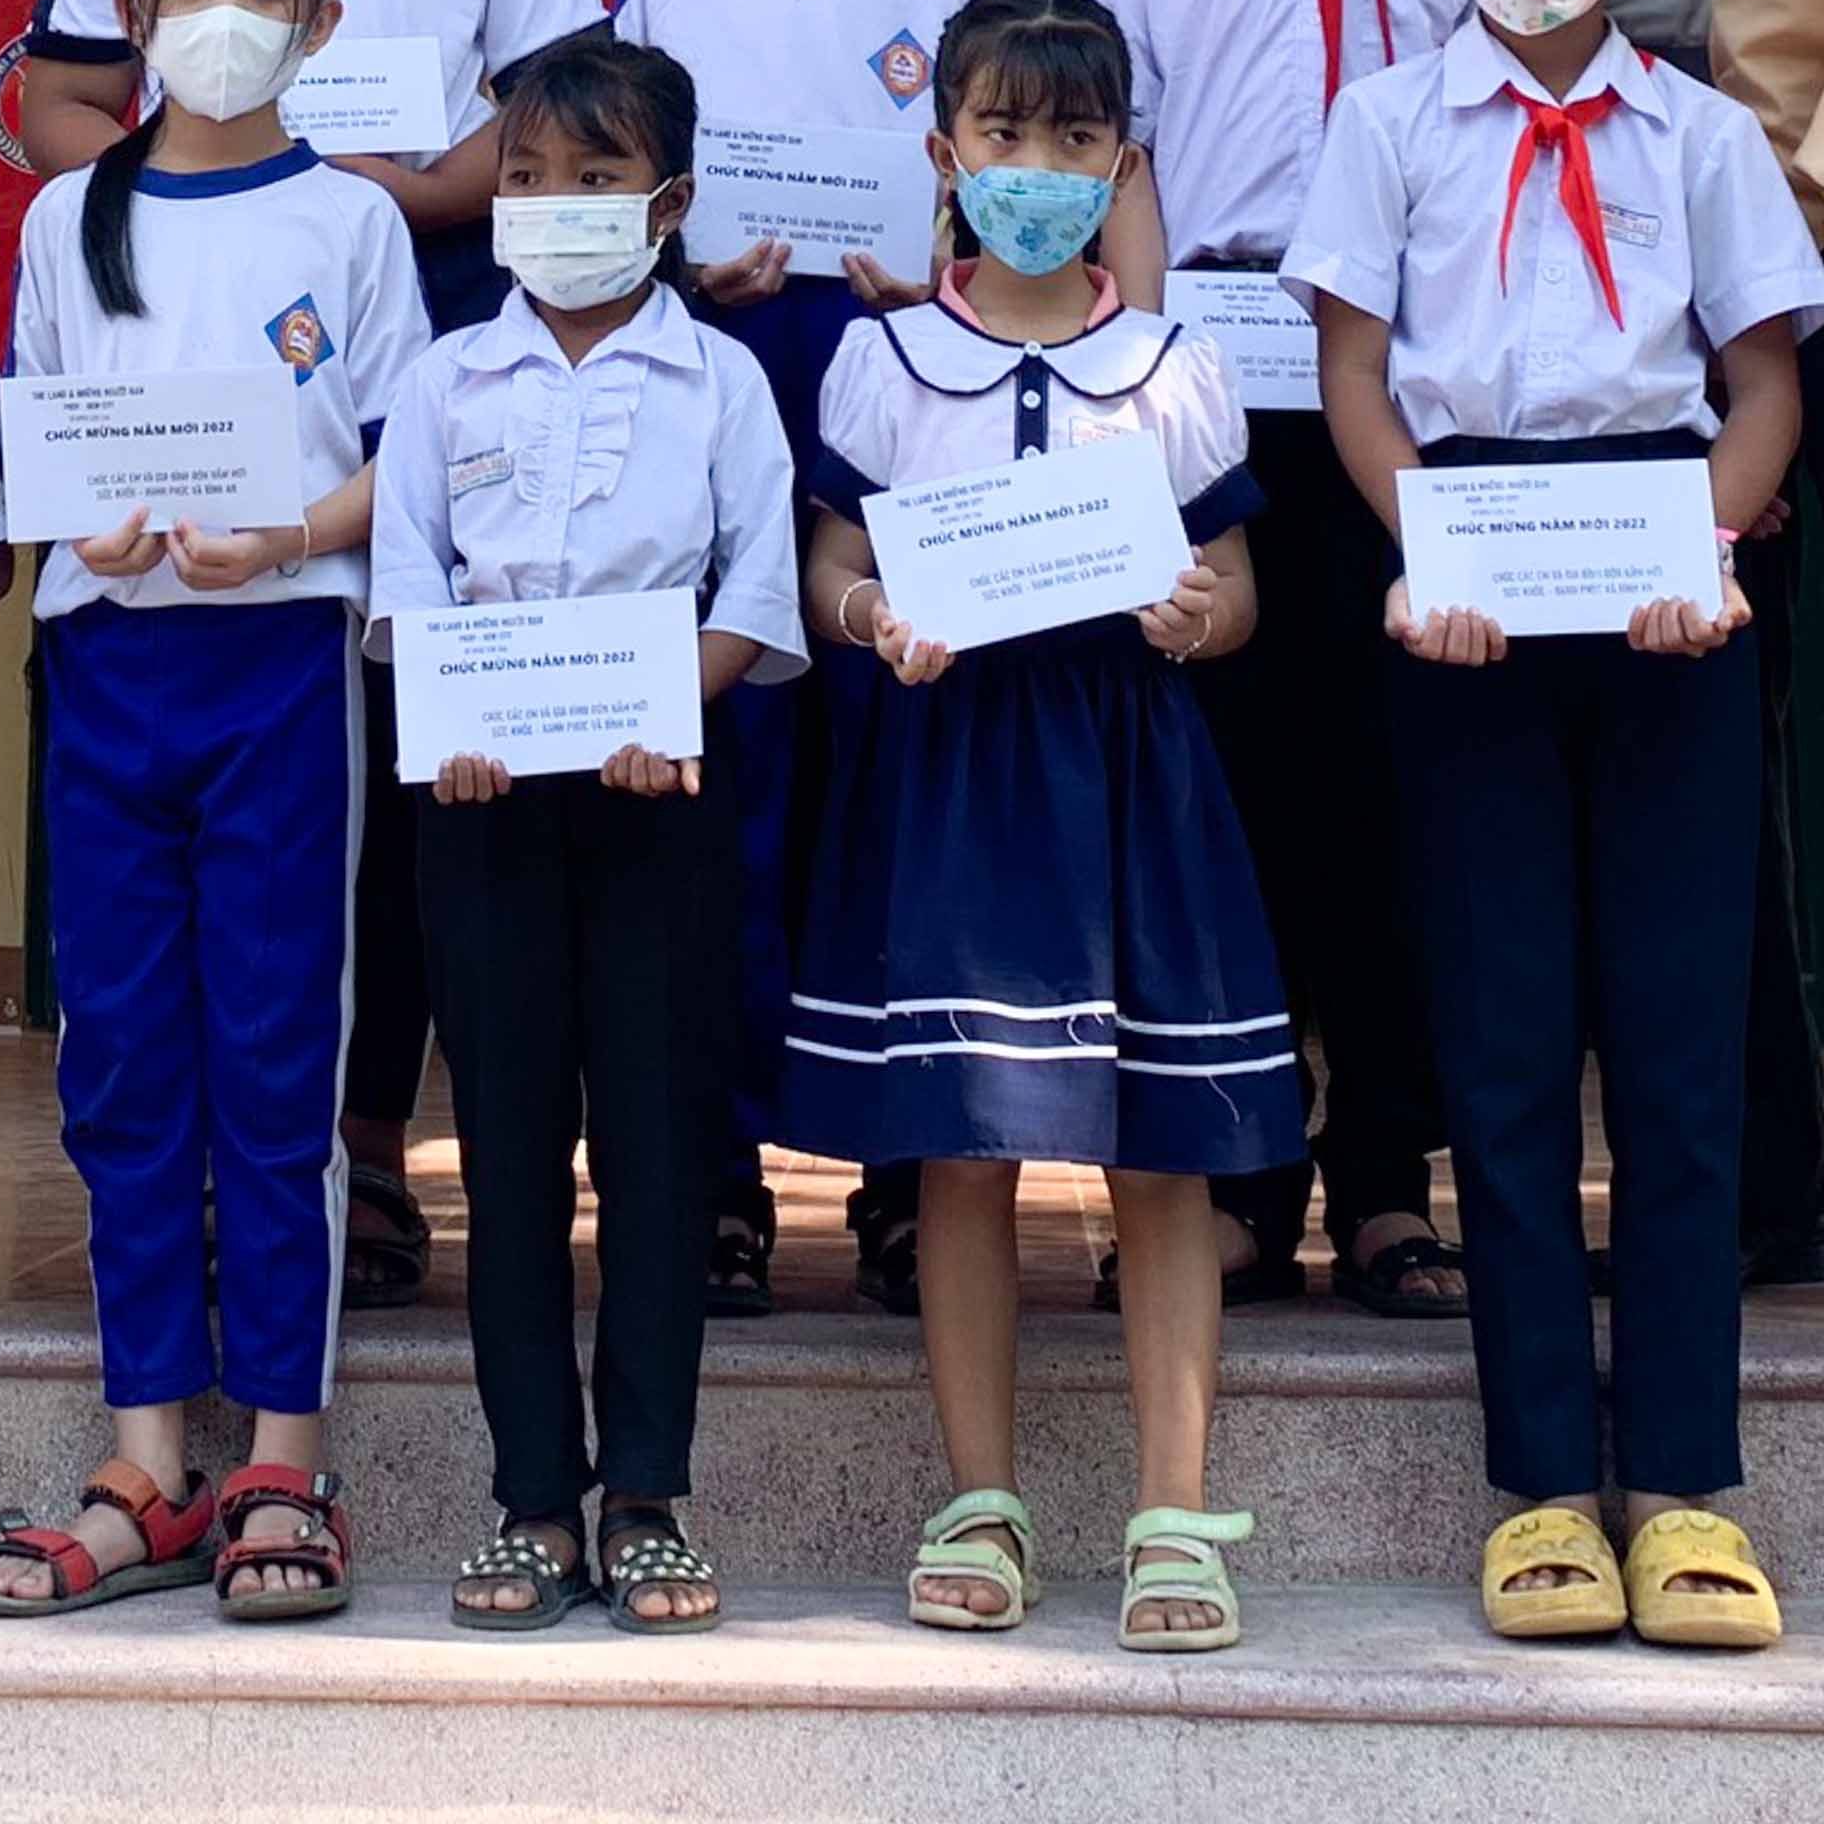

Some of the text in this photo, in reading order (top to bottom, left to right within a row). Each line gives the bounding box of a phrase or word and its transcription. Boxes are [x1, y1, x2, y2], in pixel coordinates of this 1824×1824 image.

[705, 163, 740, 179] CHÚC
[742, 166, 783, 182] MỪNG
[786, 169, 817, 185] NĂM
[849, 177, 879, 190] 2022
[44, 425, 81, 441] CHÚC
[85, 423, 130, 439] MỪNG
[133, 421, 165, 436] NĂM
[202, 420, 234, 433] 2022
[917, 527, 956, 549] CHÚC
[957, 516, 1005, 540] MỪNG
[1006, 508, 1042, 530] NĂM
[1076, 497, 1110, 515] 2022
[439, 659, 478, 677] CHÚC
[480, 655, 527, 673] MỪNG
[530, 652, 565, 669] NĂM
[602, 649, 635, 663] 2022
